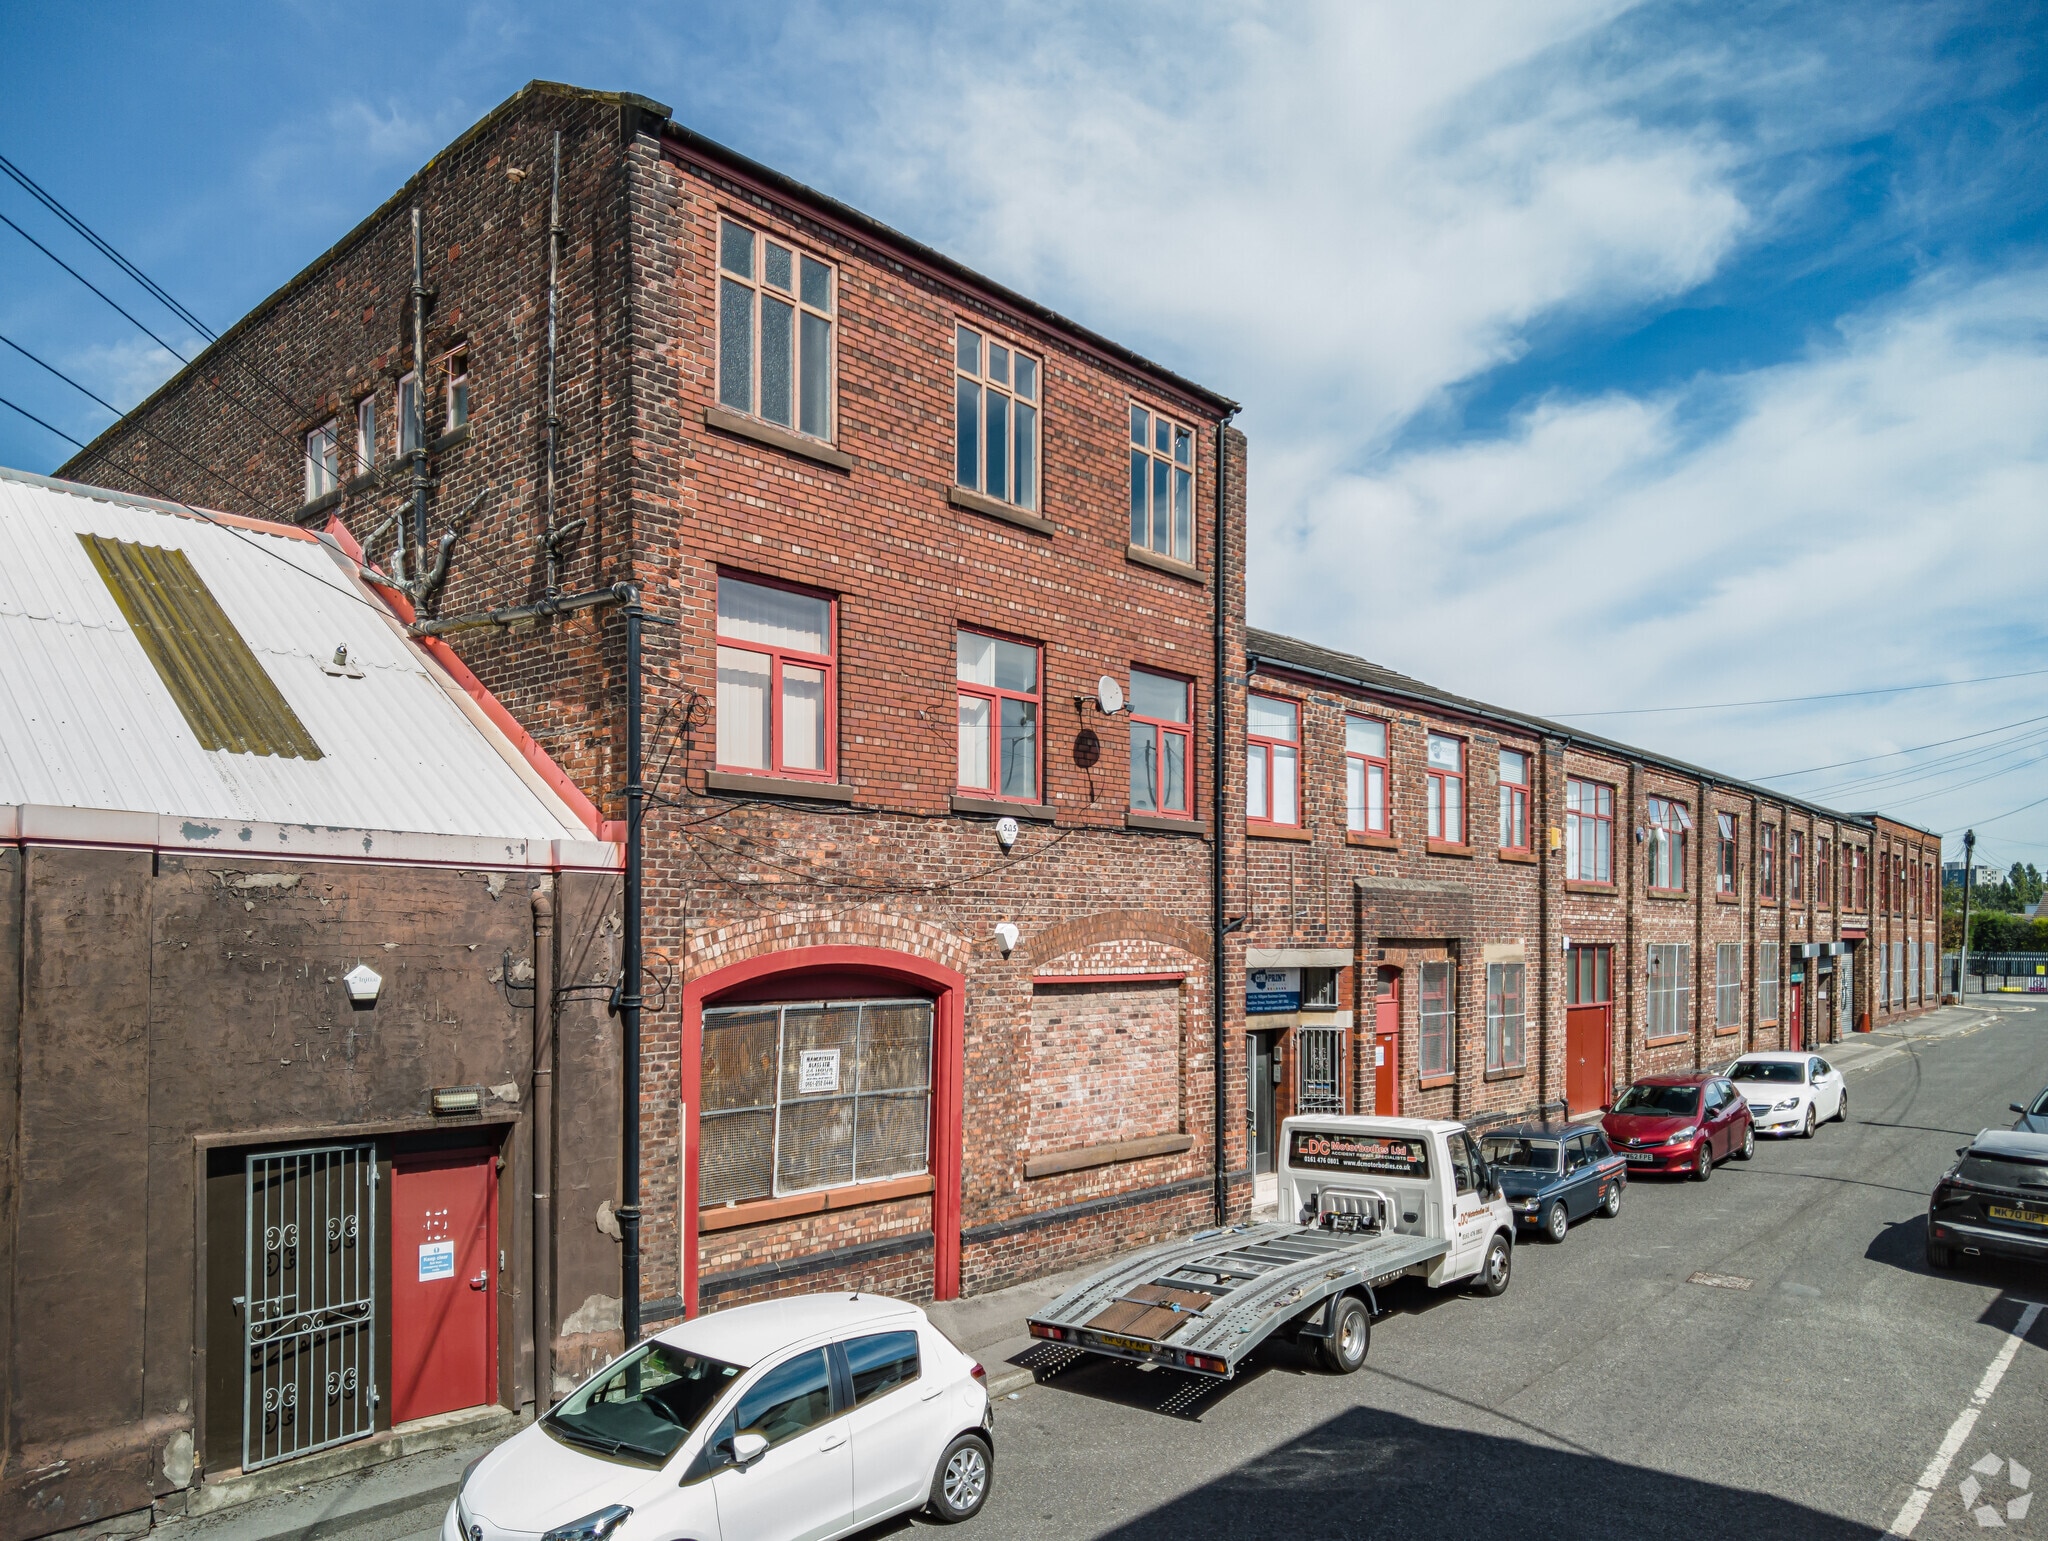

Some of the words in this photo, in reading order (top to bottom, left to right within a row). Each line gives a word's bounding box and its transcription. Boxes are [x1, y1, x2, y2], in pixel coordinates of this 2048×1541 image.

[1267, 973, 1287, 982] PRINT
[1308, 1139, 1331, 1155] DC
[1331, 1141, 1389, 1155] Motorbodies
[1391, 1145, 1407, 1156] Ltd
[1304, 1155, 1316, 1163] 0161
[1317, 1156, 1327, 1164] 476
[1327, 1157, 1340, 1165] 0801
[1343, 1159, 1411, 1171] www.dcmotorbodies.co.uk
[1375, 1153, 1407, 1161] SPECIALISTS
[1994, 1207, 2022, 1219] MK70
[2025, 1211, 2047, 1223] UPT
